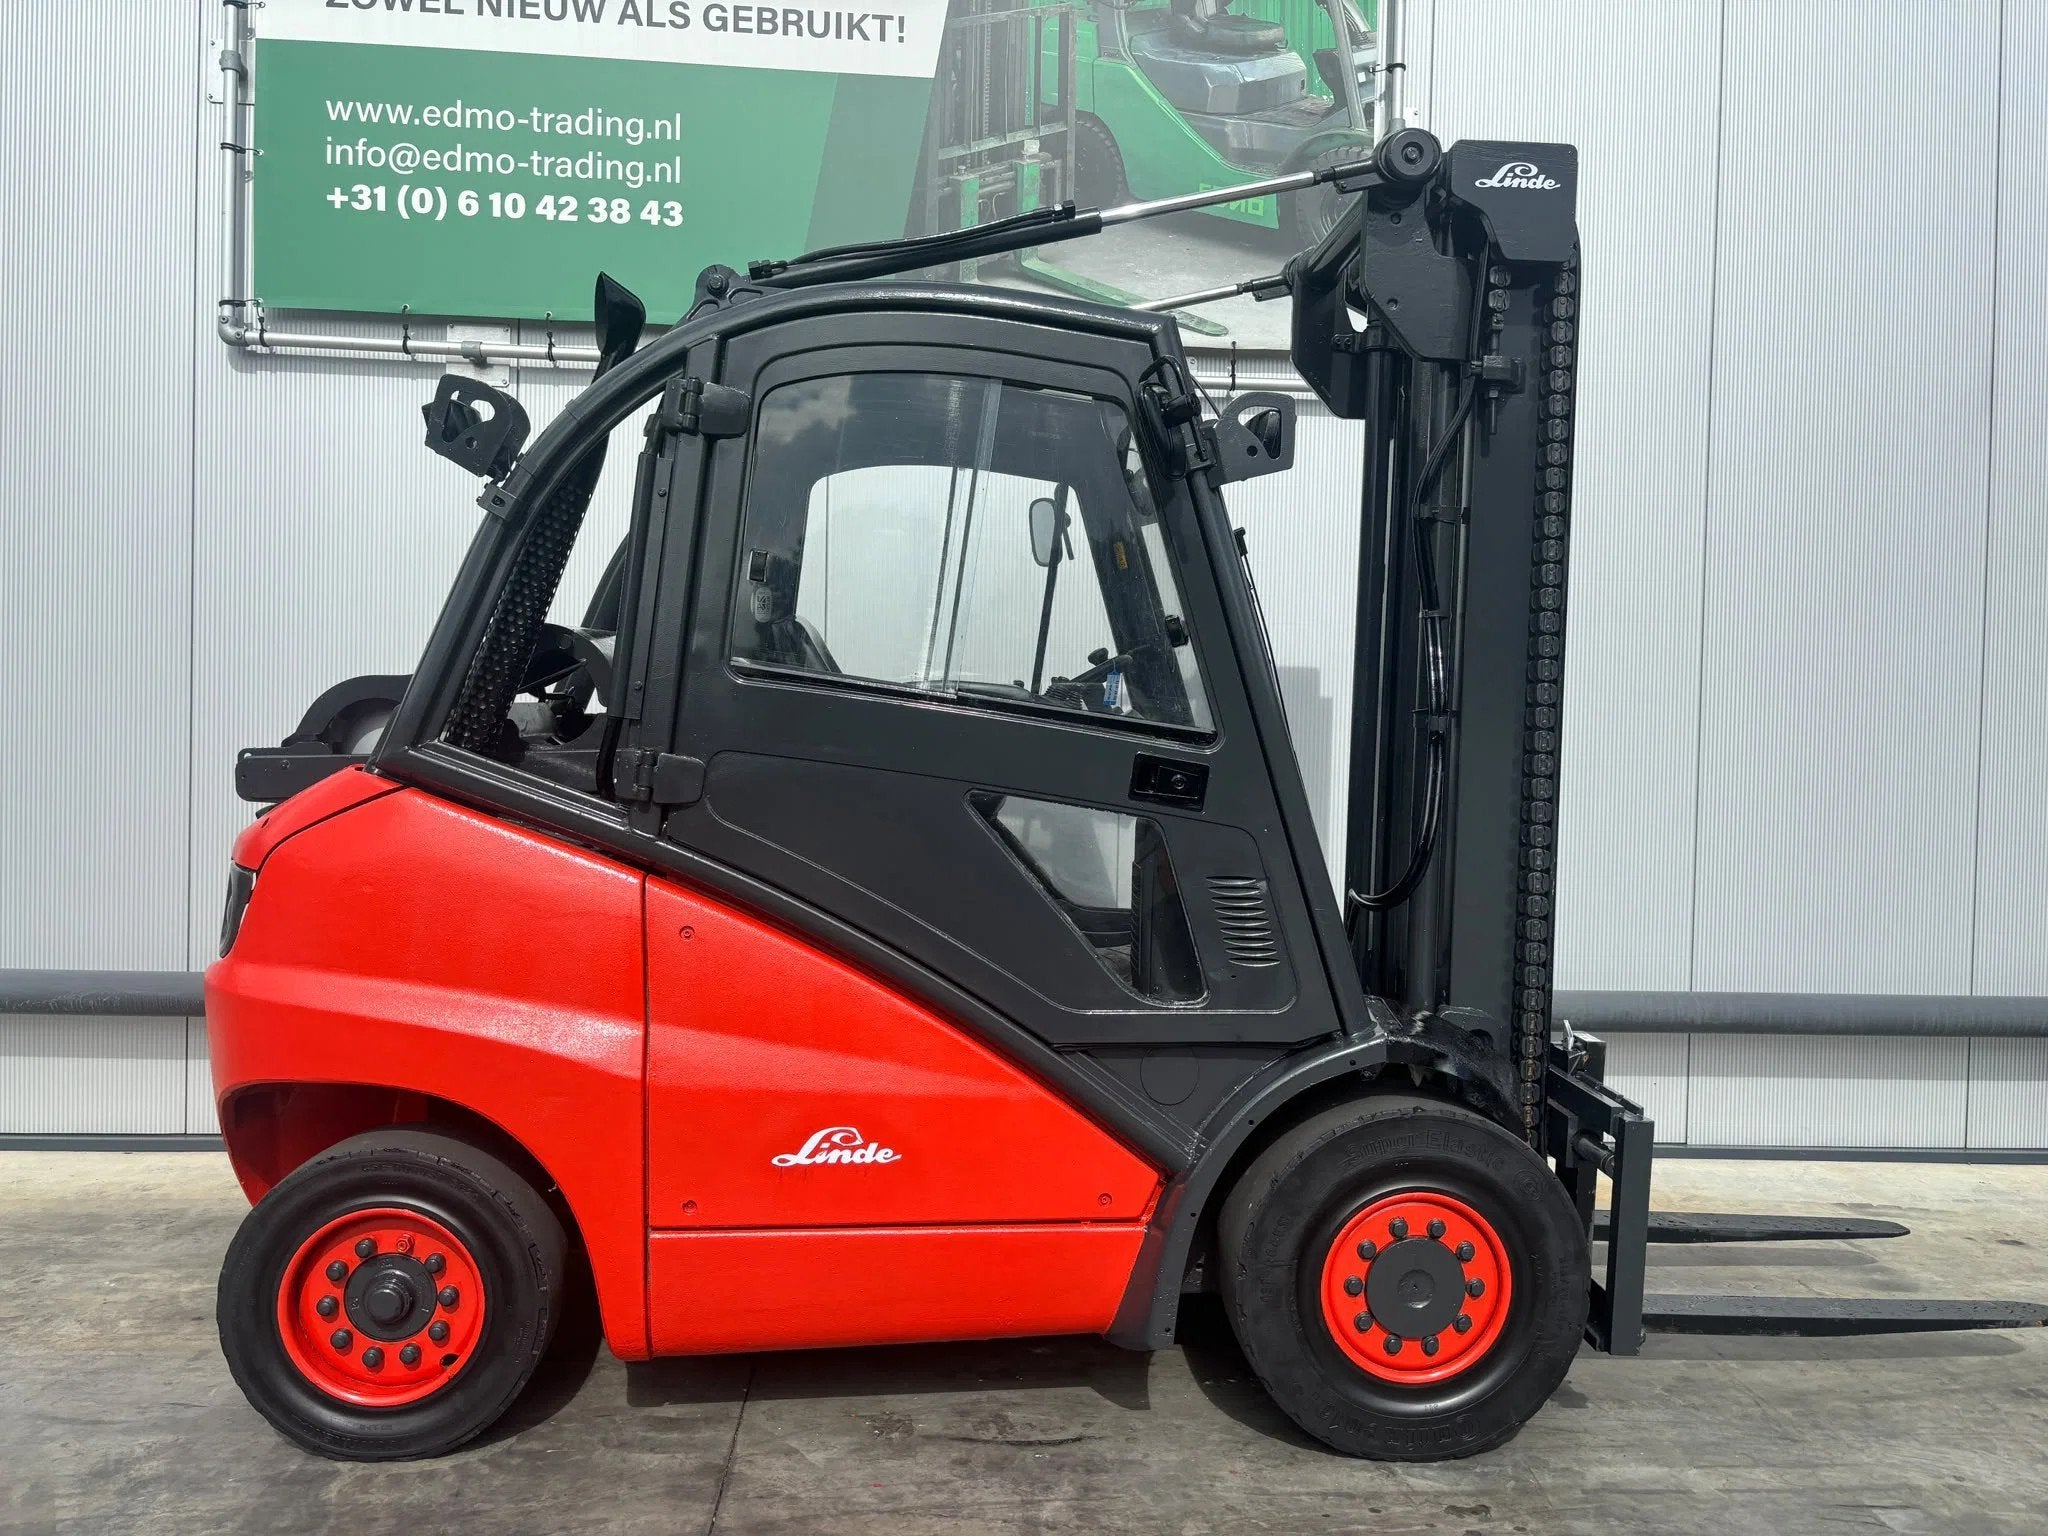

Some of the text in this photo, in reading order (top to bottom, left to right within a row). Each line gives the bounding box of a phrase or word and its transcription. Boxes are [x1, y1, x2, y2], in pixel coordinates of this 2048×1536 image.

[478, 0, 607, 23] NIEUW
[617, 0, 691, 29] ALS
[702, 4, 905, 43] GEBRUIKT!
[326, 100, 681, 146] www.edmo-trading.nl
[326, 136, 681, 189] info@edmo-trading.nl
[1475, 162, 1561, 189] Linde
[326, 184, 684, 227] +31 (0) 6 10 42 38 43
[771, 1126, 902, 1167] Linde
